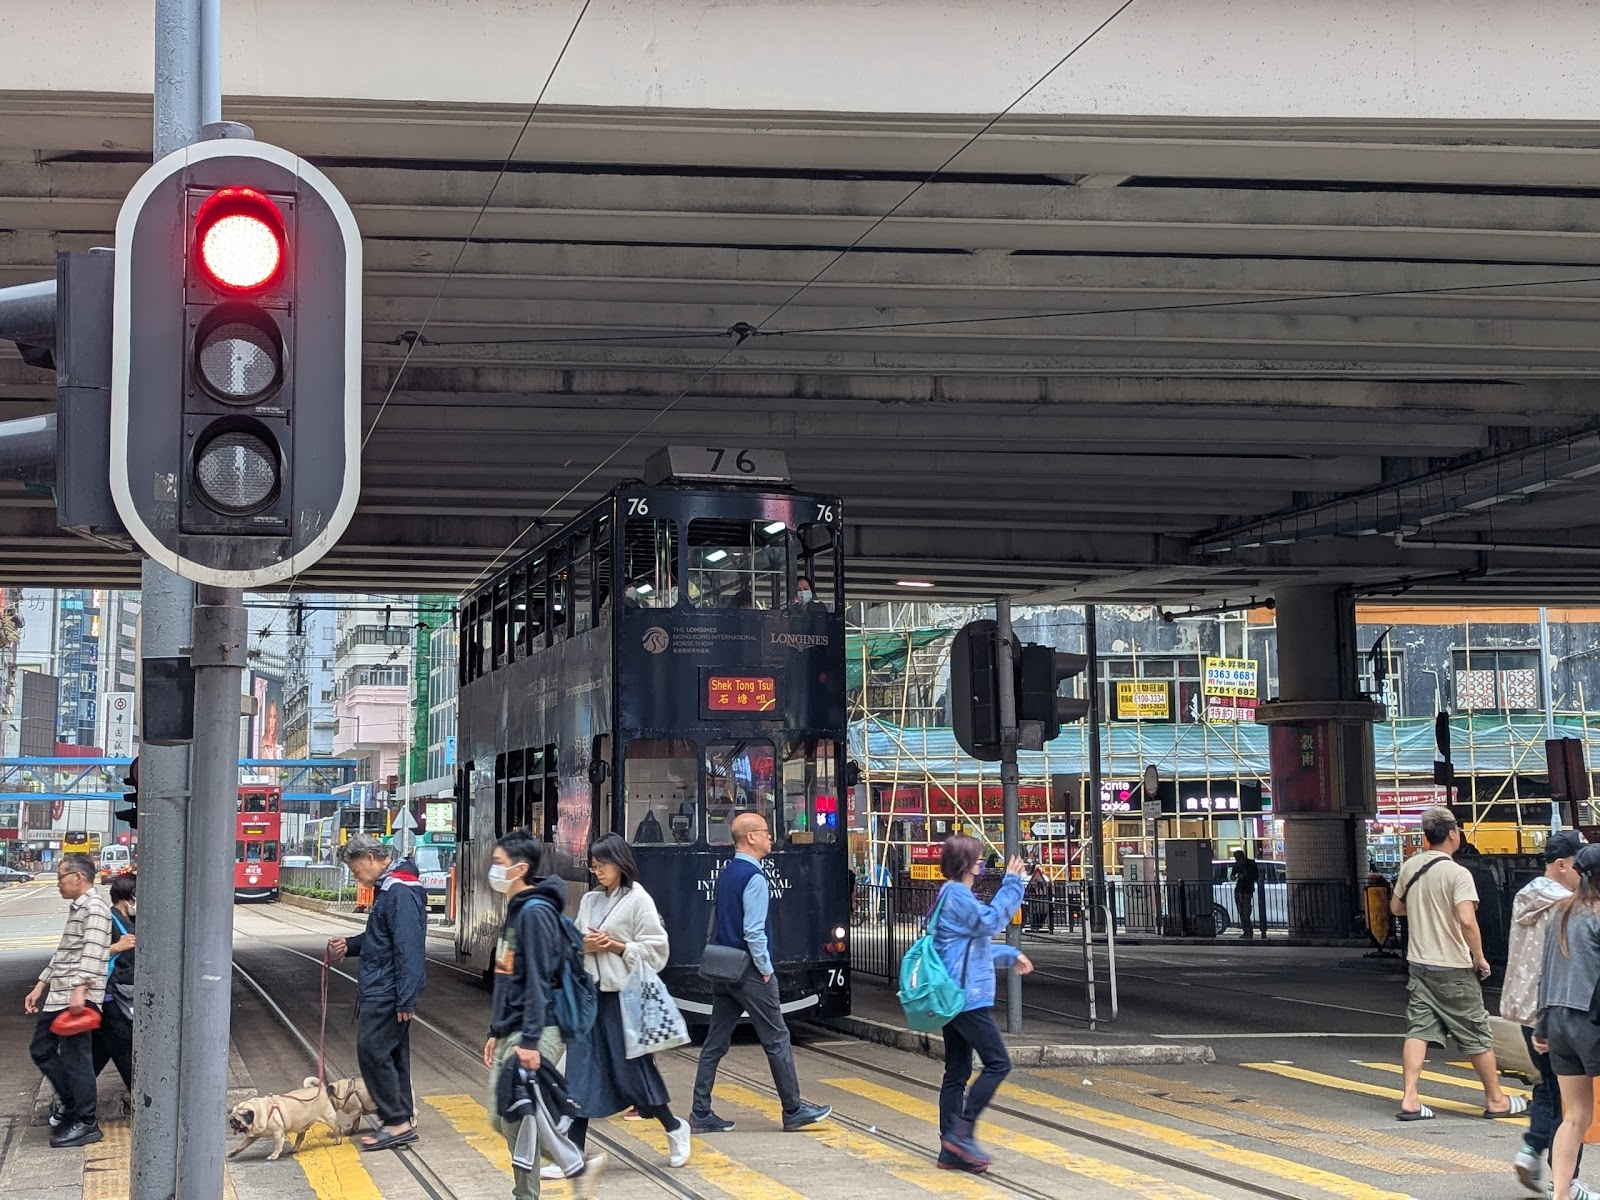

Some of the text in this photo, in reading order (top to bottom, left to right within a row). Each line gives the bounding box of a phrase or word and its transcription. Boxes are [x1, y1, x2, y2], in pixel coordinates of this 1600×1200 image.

[706, 447, 756, 473] 76
[627, 497, 649, 516] 76
[816, 504, 833, 523] 76
[686, 626, 718, 634] LONGINES
[770, 633, 829, 646] LONGINES
[1208, 669, 1255, 681] 9363 6681
[711, 679, 774, 692] Shek Tong Tsui
[1207, 686, 1230, 694] 2781
[716, 859, 775, 869] LOES
[827, 968, 845, 987] 76
